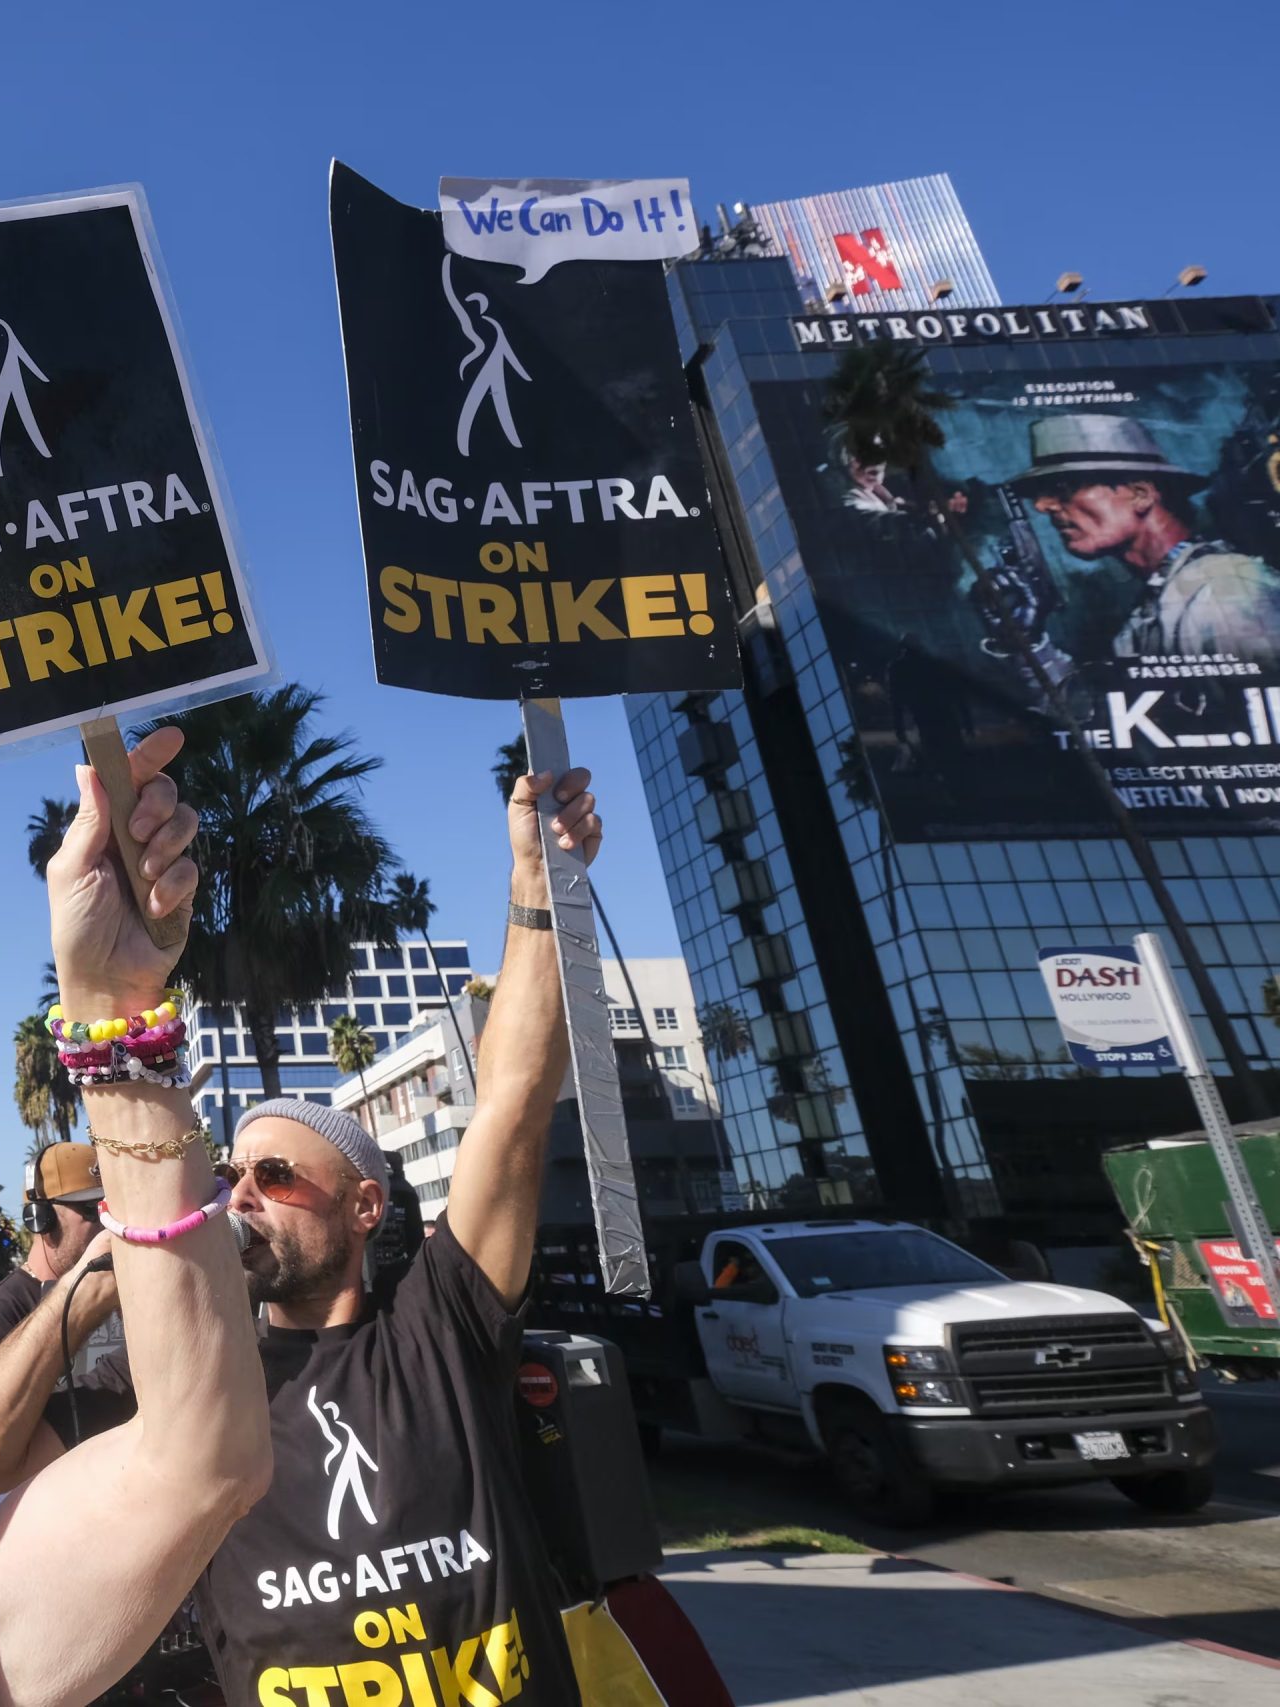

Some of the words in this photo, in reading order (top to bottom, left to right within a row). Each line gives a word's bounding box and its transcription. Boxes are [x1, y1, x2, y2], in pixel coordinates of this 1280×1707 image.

[457, 198, 514, 235] We
[520, 195, 572, 236] Can
[582, 196, 624, 237] Do
[794, 306, 1150, 345] METROPOLITAN
[1024, 380, 1116, 394] EXECUTION
[1012, 396, 1028, 407] IS
[479, 541, 549, 574] ON
[29, 556, 95, 600] ON
[378, 565, 715, 645] STRIKE!
[1140, 653, 1239, 665] MICHAEL
[1127, 662, 1262, 679] FASSBENDER
[1114, 766, 1187, 781] SELECT
[1056, 966, 1141, 988] DASH
[1059, 992, 1132, 1001] HOLLYWOOD
[353, 1603, 427, 1648] ON
